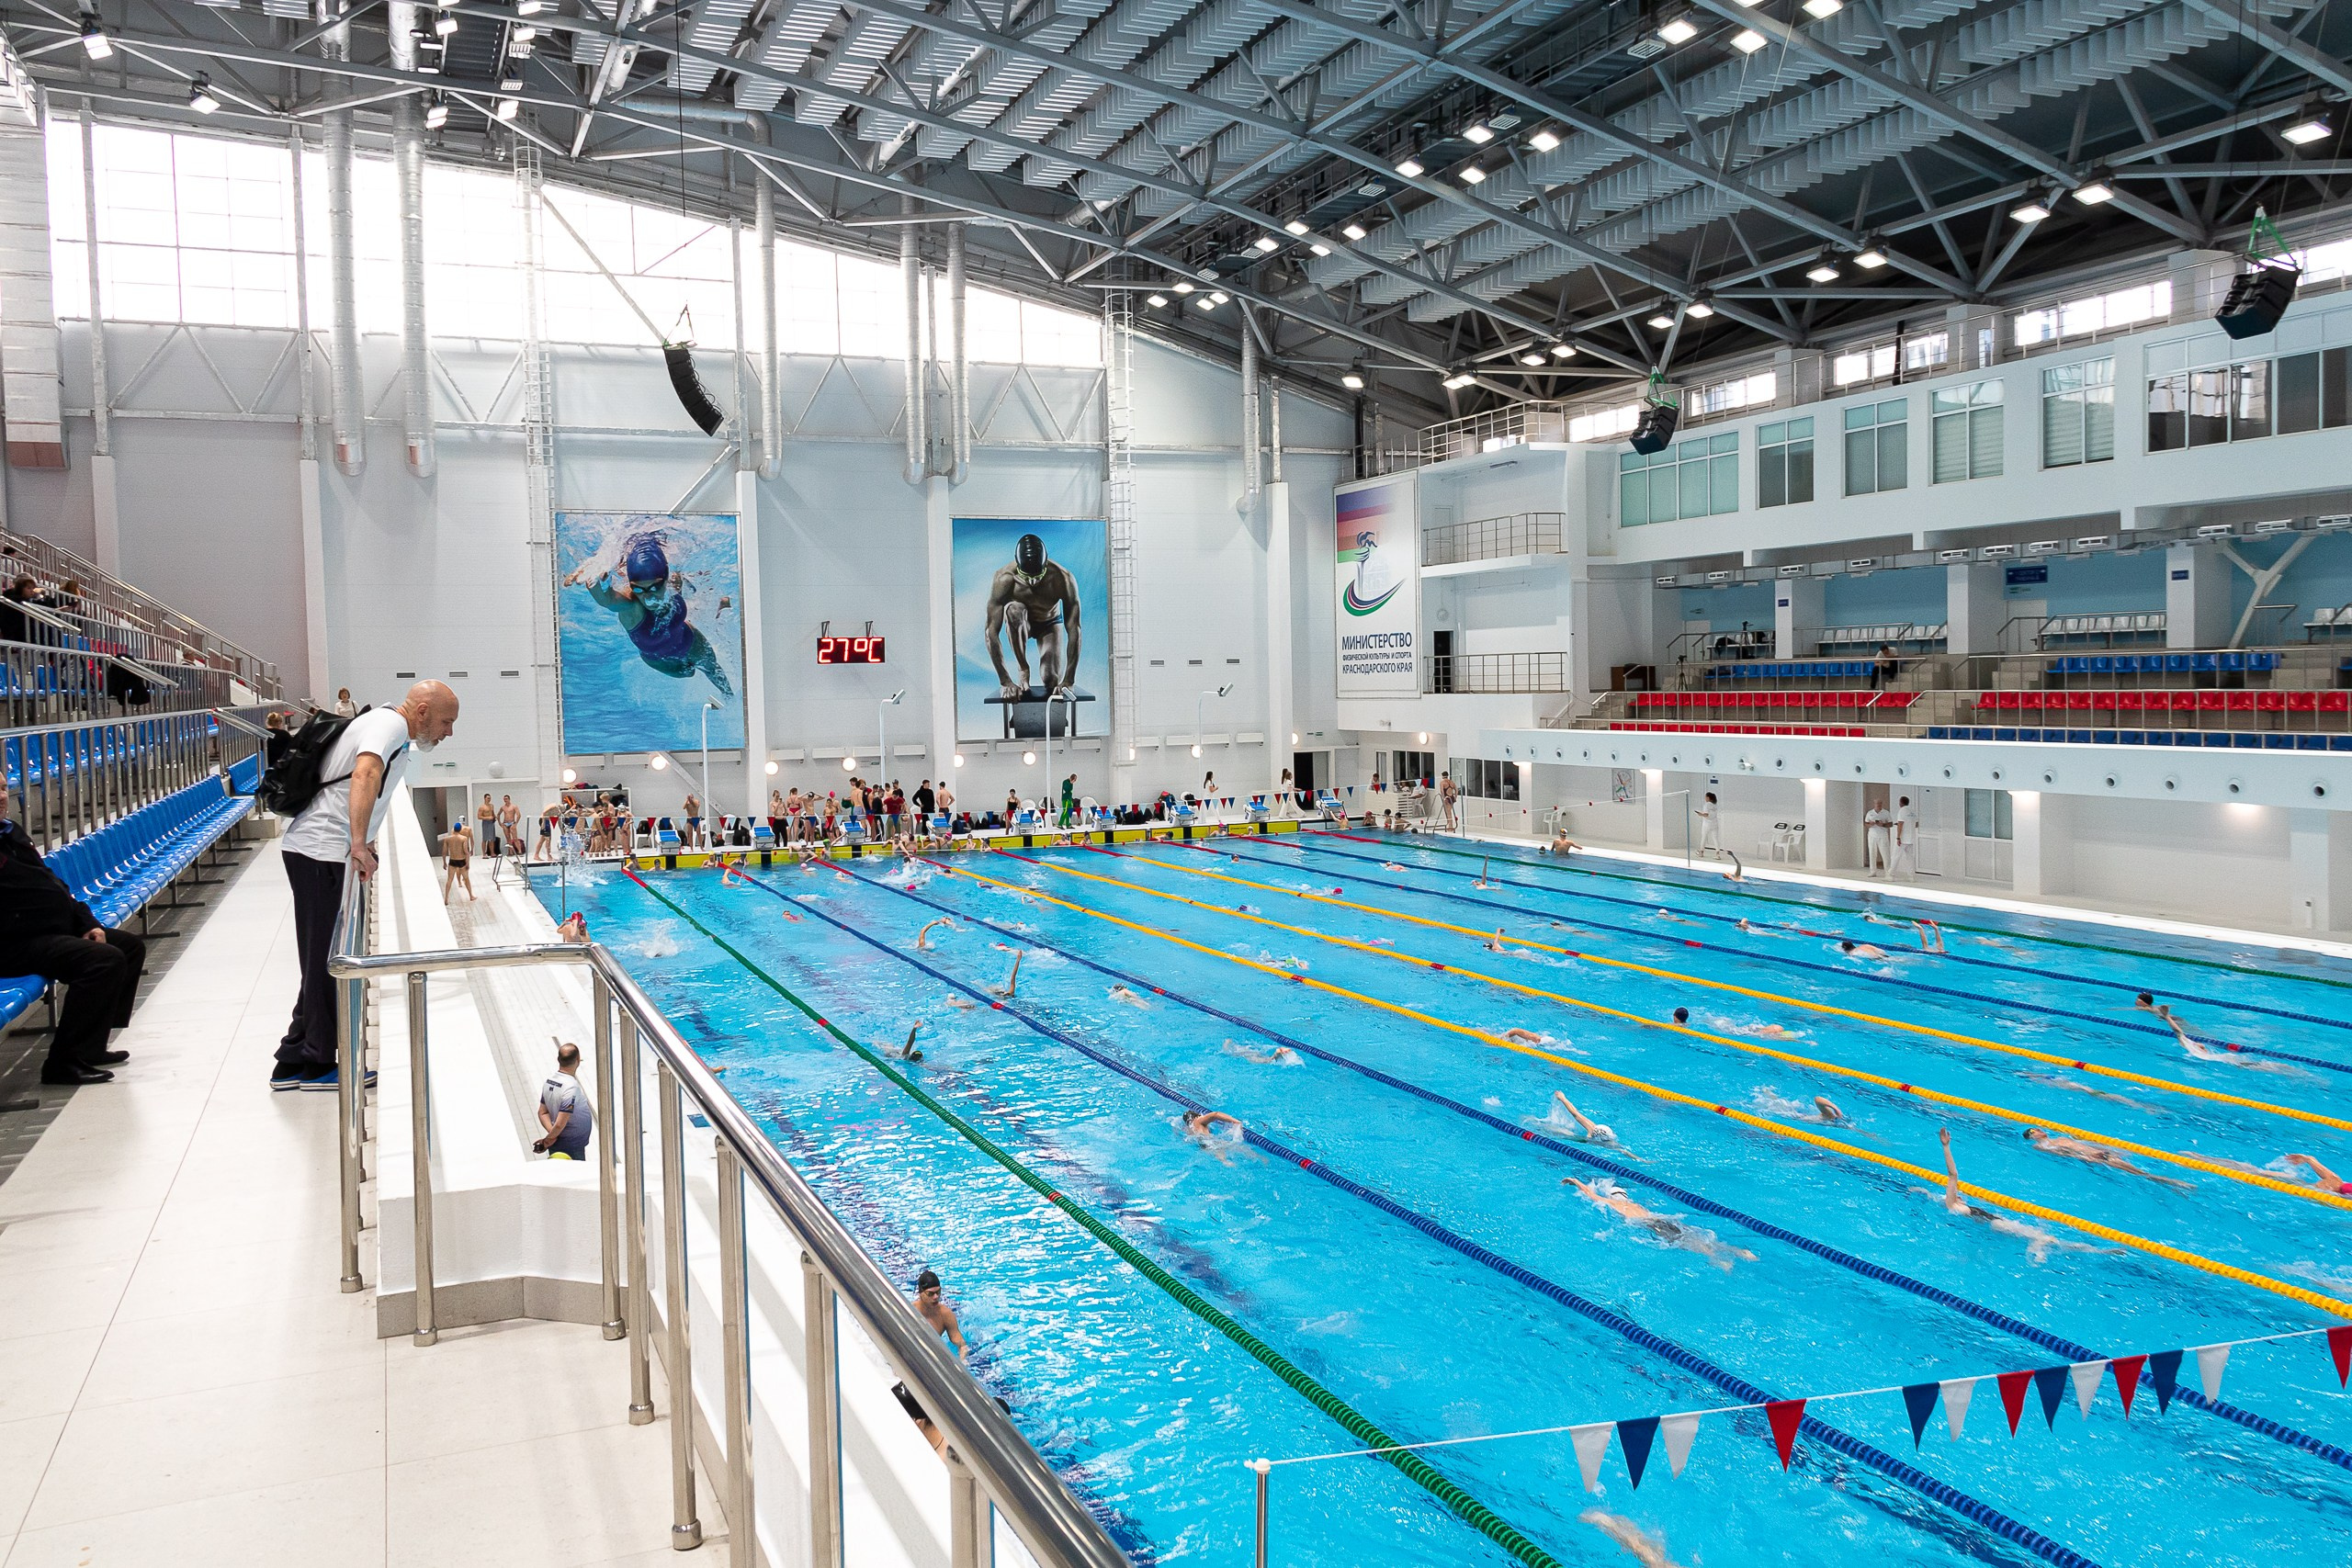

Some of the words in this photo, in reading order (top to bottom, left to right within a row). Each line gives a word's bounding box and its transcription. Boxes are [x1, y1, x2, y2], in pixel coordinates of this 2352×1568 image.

[1342, 632, 1412, 650] МИНИСТЕРСТВО
[1342, 652, 1368, 661] ФИЗИЧЕСКОЙ
[1342, 662, 1396, 675] КРАСНОДАРСКОГО
[1396, 662, 1412, 672] КРАЯ
